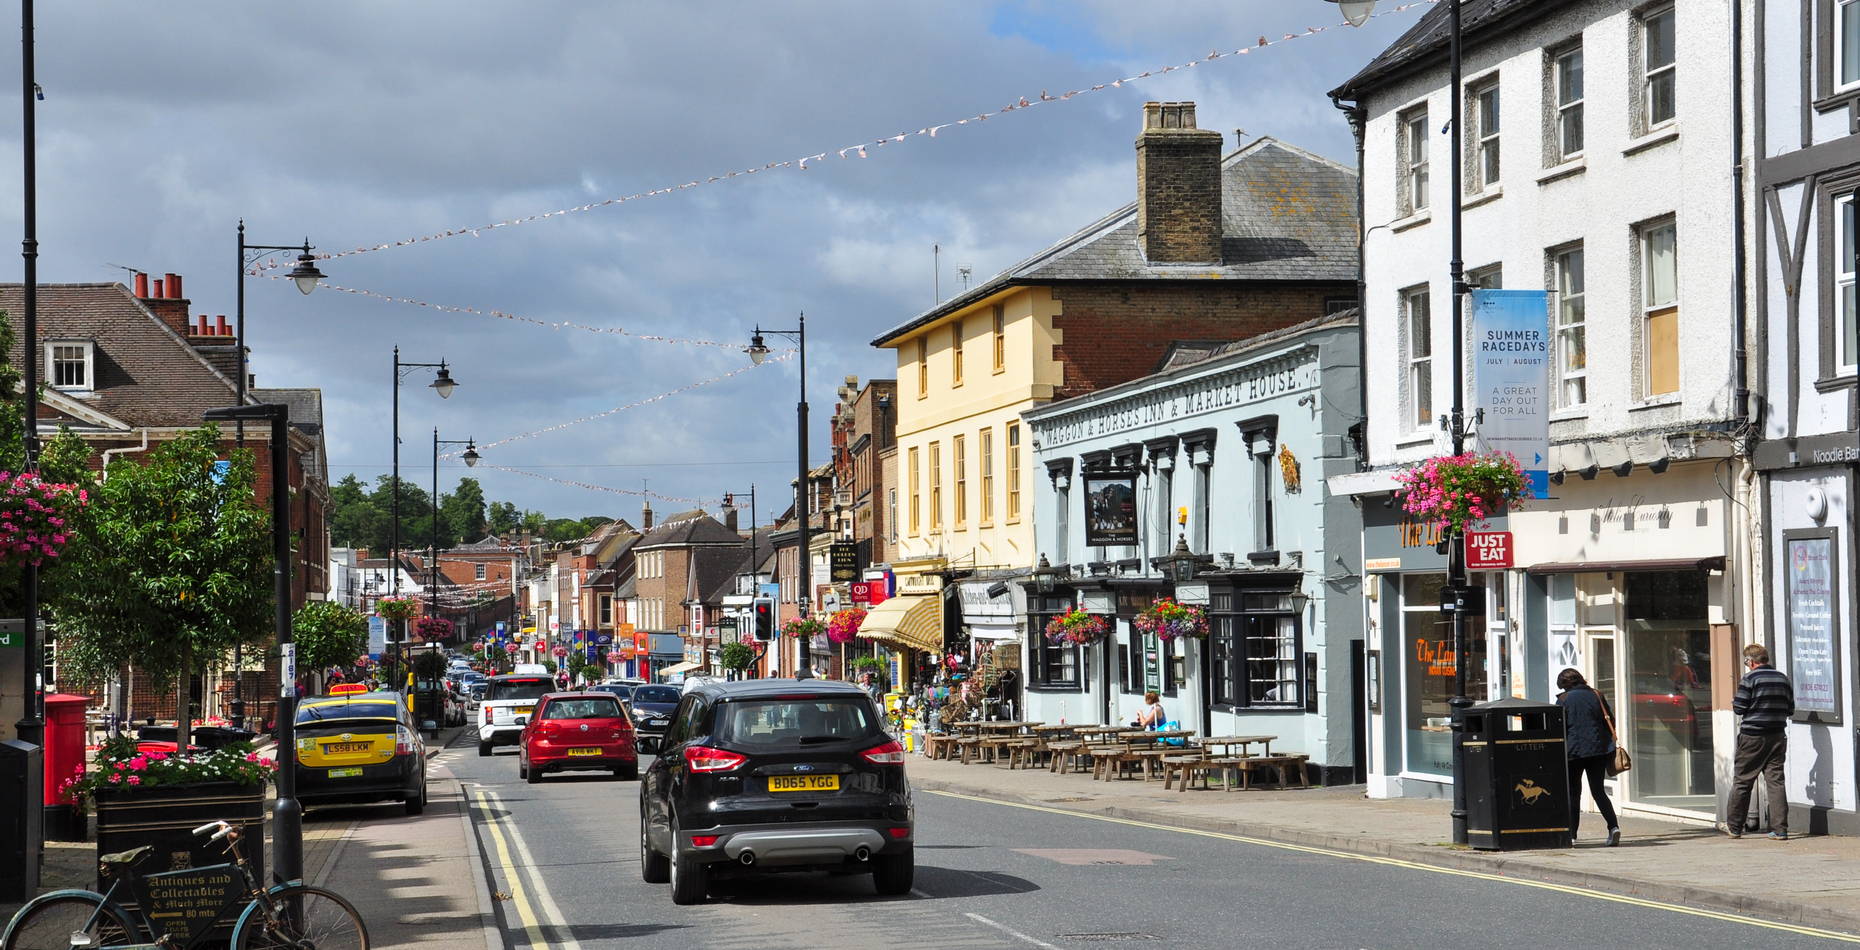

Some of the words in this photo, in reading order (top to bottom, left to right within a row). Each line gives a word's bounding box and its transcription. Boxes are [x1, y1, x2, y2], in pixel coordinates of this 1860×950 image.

[1487, 330, 1540, 341] SUMMER
[1482, 341, 1546, 352] RACEDAYS
[1492, 387, 1500, 395] A
[1503, 387, 1537, 395] GREAT
[1492, 397, 1513, 405] DAY
[1516, 396, 1538, 405] OUT
[1045, 421, 1084, 446] WAGGON
[1087, 419, 1094, 436] &
[1098, 408, 1140, 435] HORSES
[1144, 401, 1165, 423] INN
[1170, 399, 1178, 417] &
[1185, 382, 1242, 414] MARKET
[1493, 406, 1514, 415] FOR
[1517, 406, 1537, 415] ALL
[1813, 446, 1844, 464] Noodle
[1844, 446, 1860, 461] Bar
[1398, 514, 1422, 549] The
[1471, 534, 1506, 548] JUST
[1480, 547, 1507, 561] EAT
[853, 585, 868, 596] QD
[1416, 638, 1435, 663] The
[328, 744, 351, 754] LS58
[352, 743, 369, 753] LKM
[774, 777, 806, 789] BD65
[809, 776, 834, 788] YGG
[148, 876, 206, 888] Antiques
[208, 873, 231, 885] and
[150, 886, 226, 899] Collectables
[152, 900, 162, 909] &
[165, 899, 193, 909] Much
[196, 898, 224, 908] More
[186, 909, 197, 918] 80
[198, 909, 216, 918] mts
